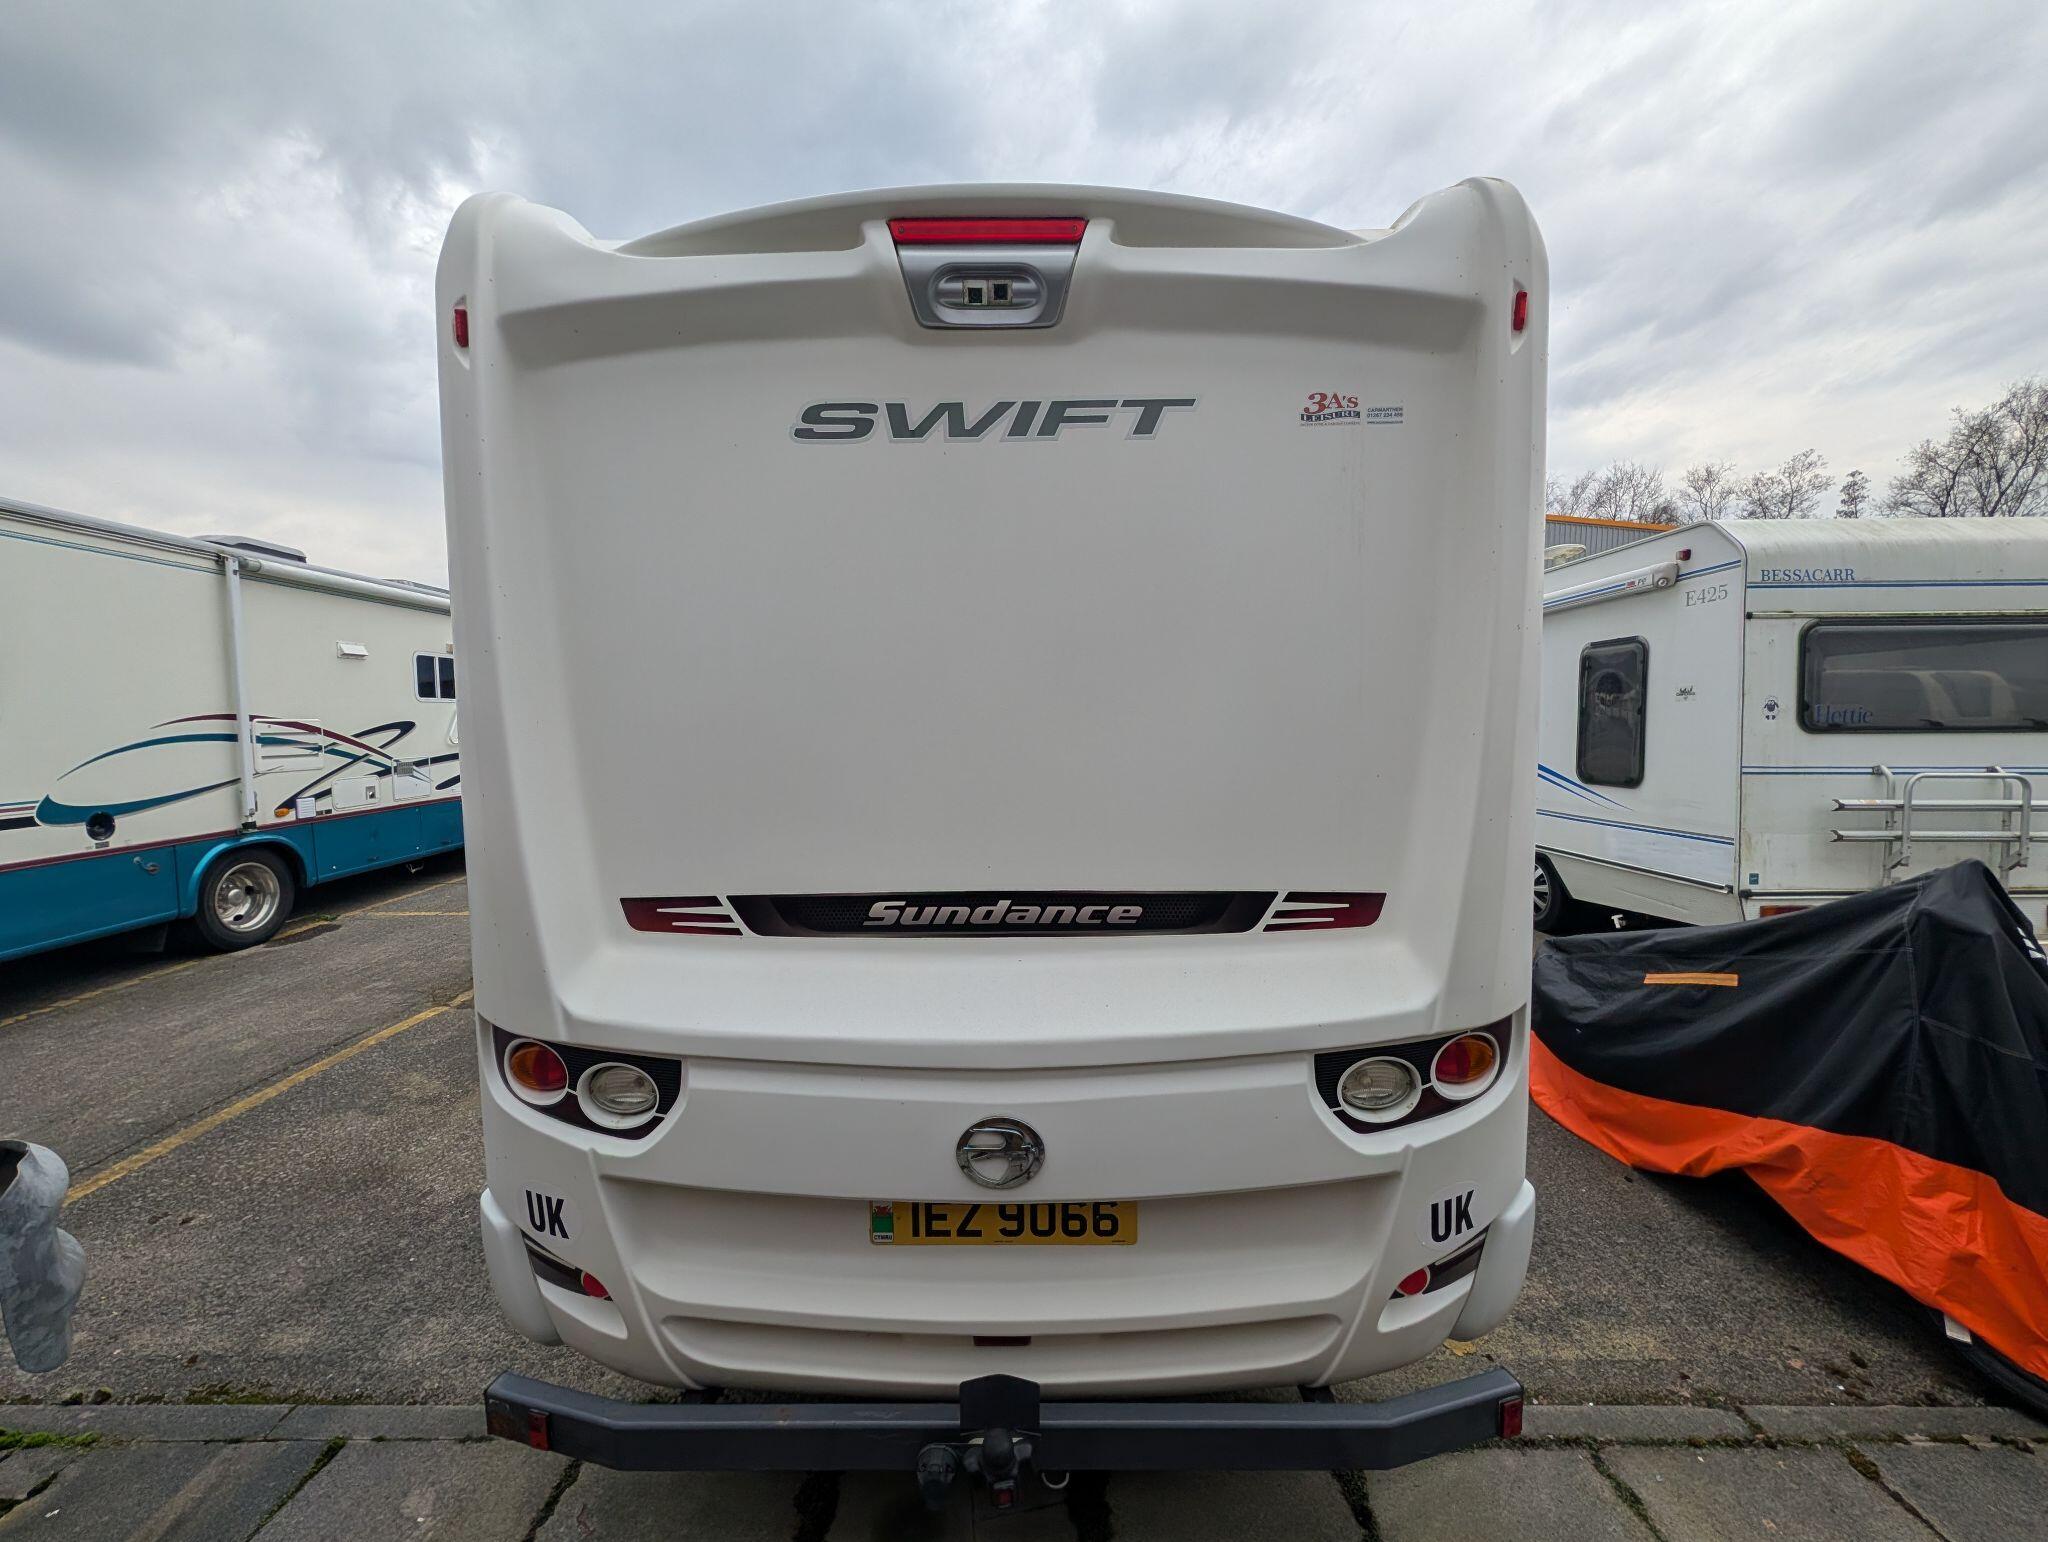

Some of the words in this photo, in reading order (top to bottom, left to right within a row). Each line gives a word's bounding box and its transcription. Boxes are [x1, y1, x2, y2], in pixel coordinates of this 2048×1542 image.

[1301, 410, 1360, 422] LEISURE
[1303, 392, 1359, 414] 3A's
[792, 398, 1198, 441] SWIFT
[1761, 568, 1855, 582] BESSACARR
[1685, 584, 1728, 607] E425
[863, 899, 1143, 926] Sundance
[525, 1189, 570, 1240] UK
[911, 1201, 983, 1238] IEZ
[998, 1202, 1119, 1238] 9066
[1431, 1189, 1474, 1243] UK
